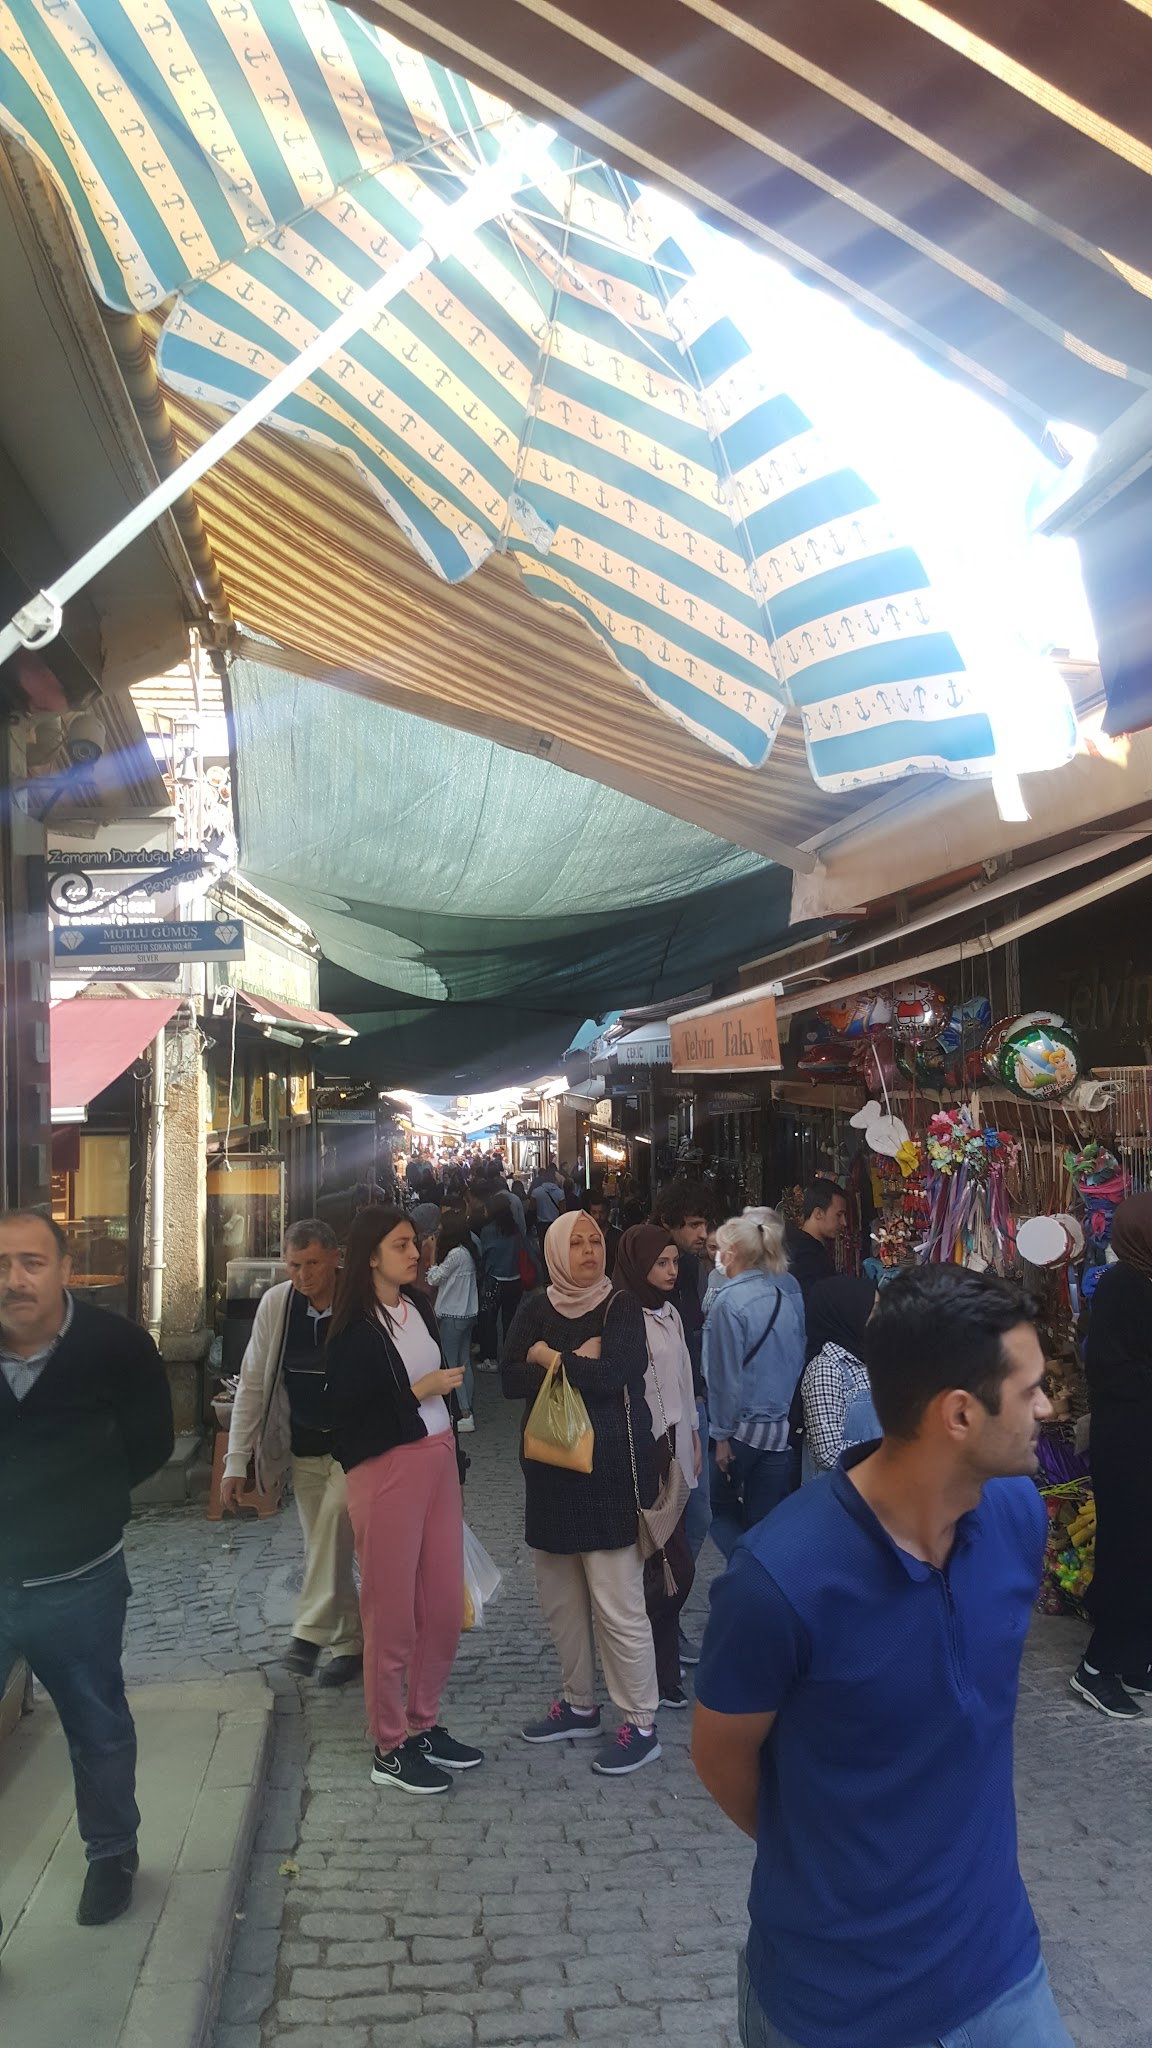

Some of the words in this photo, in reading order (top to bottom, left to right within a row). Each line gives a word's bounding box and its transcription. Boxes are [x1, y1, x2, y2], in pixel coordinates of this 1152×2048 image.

[48, 850, 108, 864] Zamanın
[111, 848, 169, 865] Durduğu
[174, 848, 207, 864] Şehir
[104, 927, 148, 940] MUTLU
[152, 924, 198, 939] GÜMÜŞ
[682, 1029, 714, 1061] Telvin
